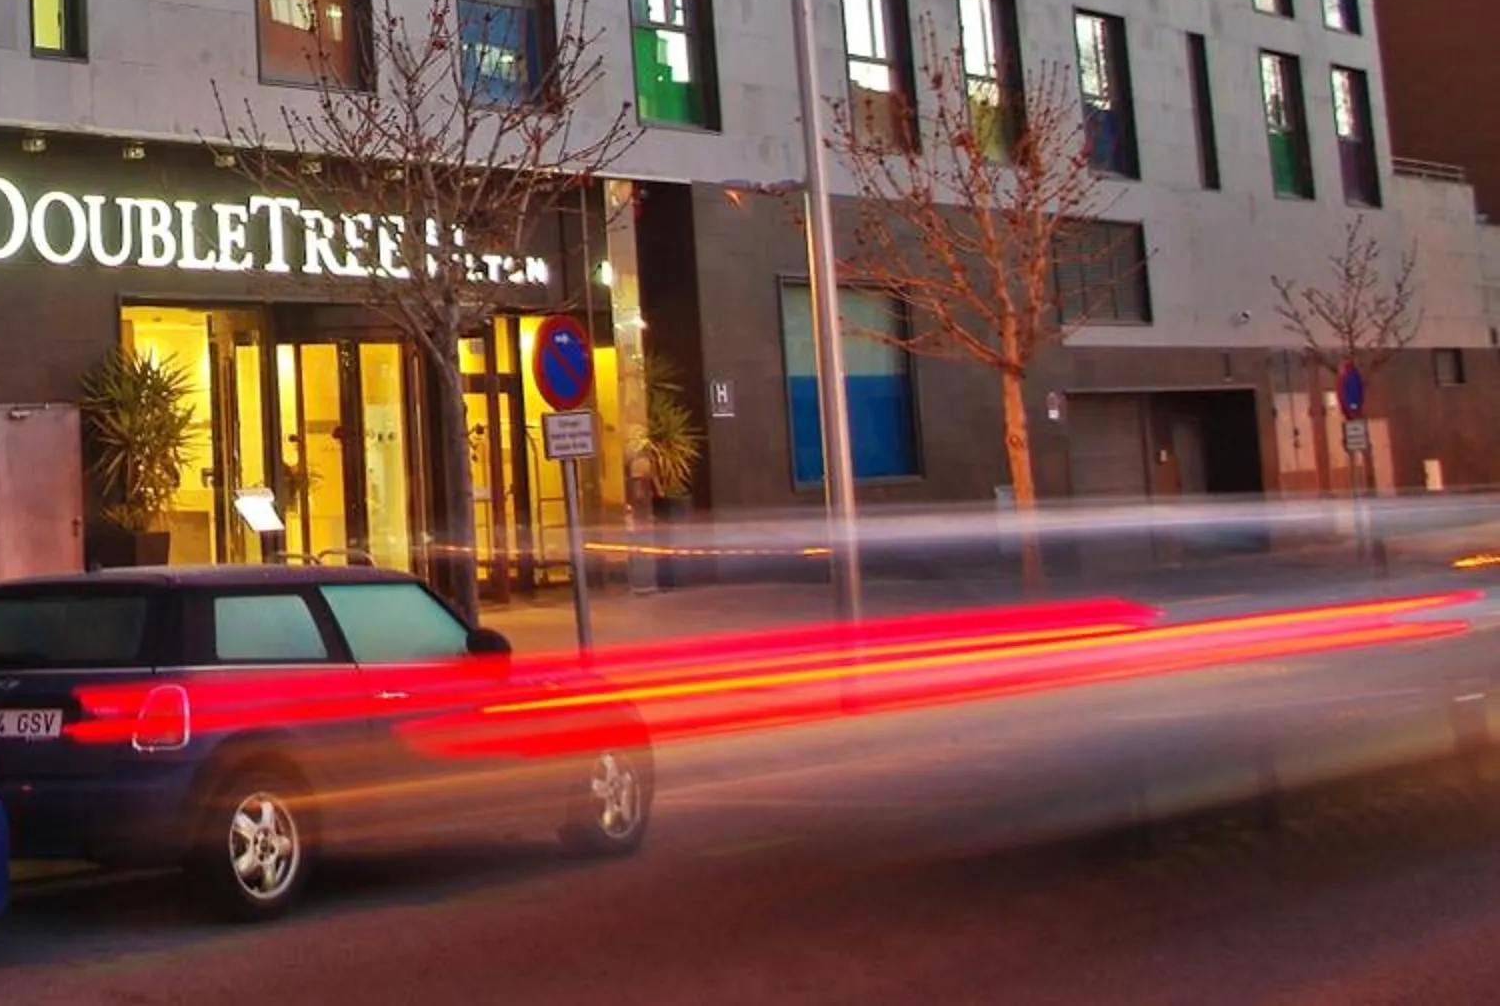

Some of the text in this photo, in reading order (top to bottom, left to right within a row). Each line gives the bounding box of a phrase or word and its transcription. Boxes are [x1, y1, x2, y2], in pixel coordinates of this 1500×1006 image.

[425, 253, 549, 285] LTON
[715, 383, 728, 403] H
[17, 712, 55, 733] GSV
